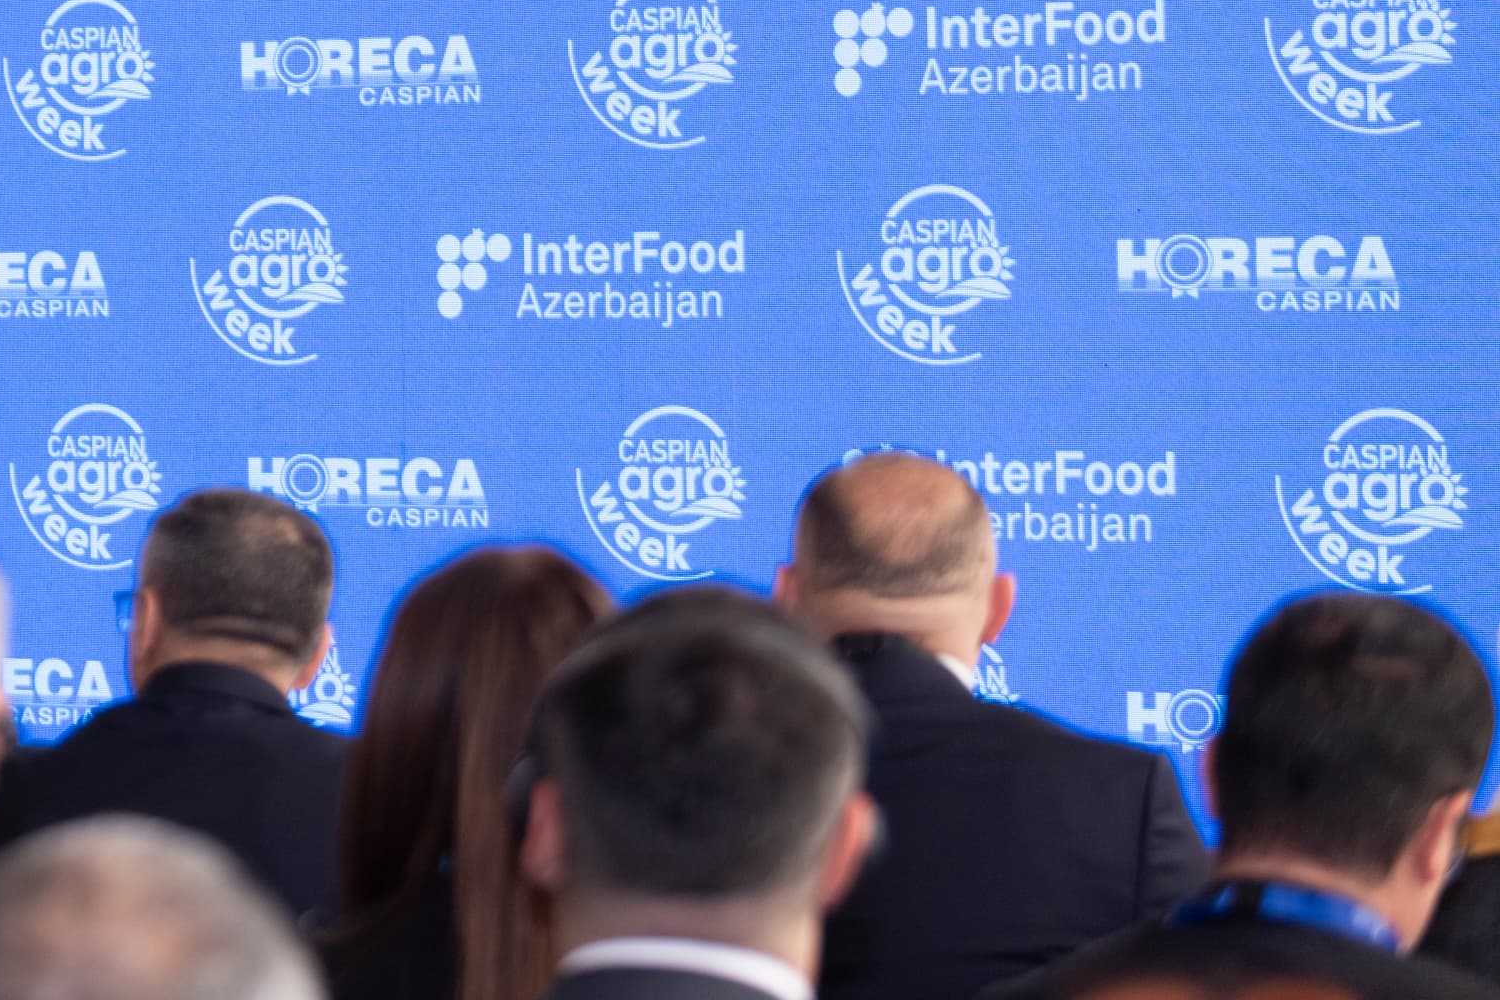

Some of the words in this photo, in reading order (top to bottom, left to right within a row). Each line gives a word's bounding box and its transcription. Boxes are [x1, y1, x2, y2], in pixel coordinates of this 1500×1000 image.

[40, 25, 139, 51] CASPIAN
[610, 6, 719, 33] CASPIAN
[1312, 3, 1443, 59] agro
[40, 46, 143, 94] agro
[241, 35, 478, 92] HORECA
[610, 27, 726, 78] agro
[359, 84, 481, 106] CASPIAN
[580, 52, 682, 139] week
[920, 53, 1141, 101] Azerbaijan
[1281, 31, 1395, 123] week
[15, 70, 104, 150] week
[229, 228, 330, 252] CASPIAN
[522, 229, 745, 275] InterFood
[881, 219, 995, 245] CASPIAN
[229, 248, 337, 295] agro
[881, 242, 1002, 294] agro
[1117, 235, 1398, 292] HORECA
[203, 270, 296, 355] week
[516, 281, 724, 327] Azerbaijan
[852, 264, 957, 355] week
[1256, 290, 1400, 311] CASPIAN
[48, 435, 145, 456] CASPIAN
[619, 439, 727, 464] CASPIAN
[1324, 444, 1447, 469] CASPIAN
[48, 458, 151, 504] agro
[247, 456, 487, 508] HORECA
[619, 462, 734, 511] agro
[936, 449, 1177, 495] nterFood
[1324, 471, 1455, 521] agro
[22, 475, 112, 559] week
[366, 507, 489, 527] CASPIAN
[589, 482, 690, 570] week
[988, 502, 1151, 551] erbaijan
[1291, 490, 1405, 584] week
[3, 657, 113, 705] ECA
